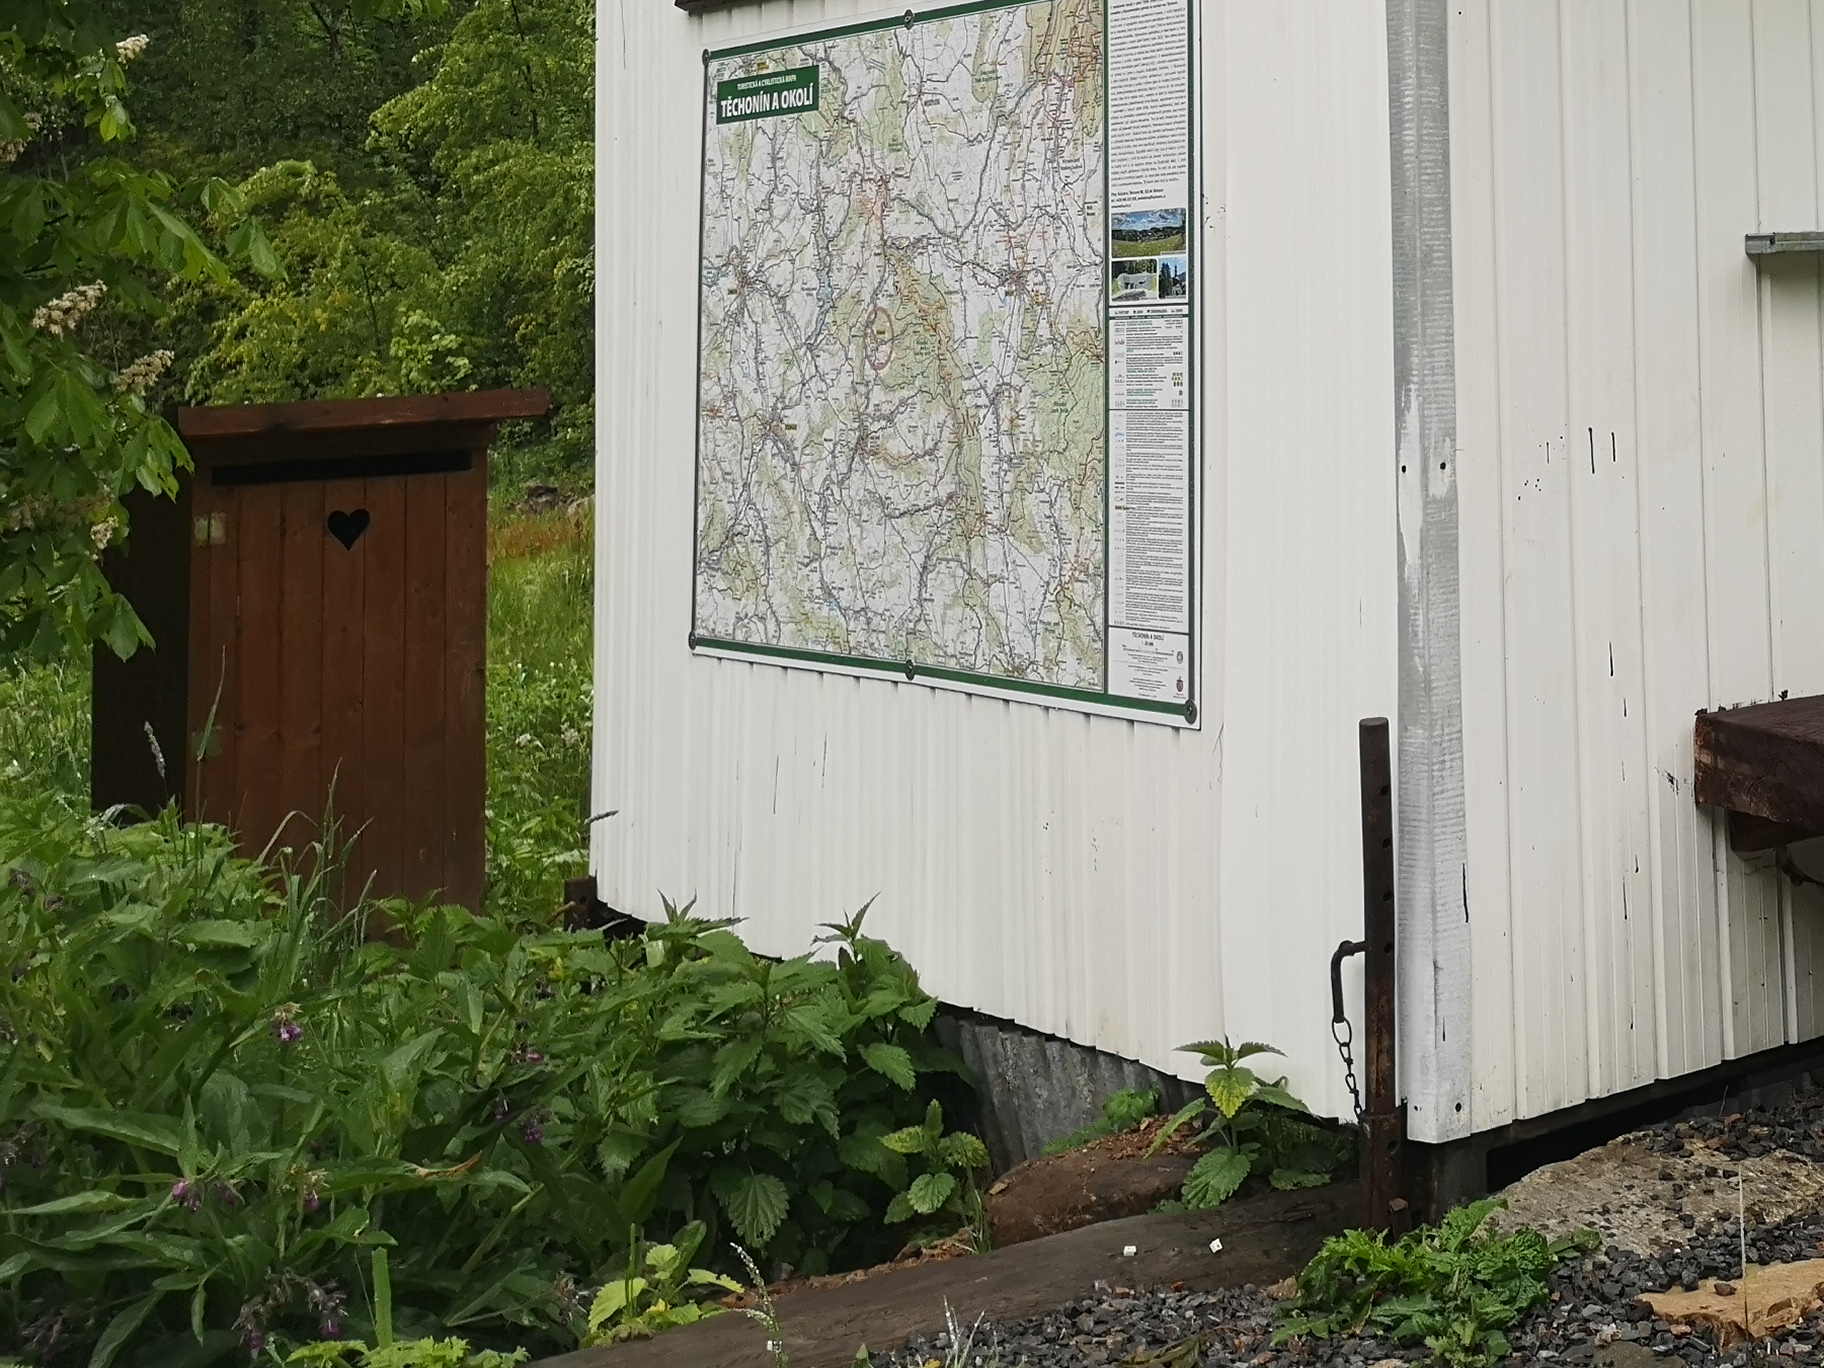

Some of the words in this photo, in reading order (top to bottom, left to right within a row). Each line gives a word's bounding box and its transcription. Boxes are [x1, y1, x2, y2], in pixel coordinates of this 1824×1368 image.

[721, 91, 770, 118] TĚCHONÍN
[771, 92, 780, 110] A
[781, 82, 814, 109] OKOLÍ
